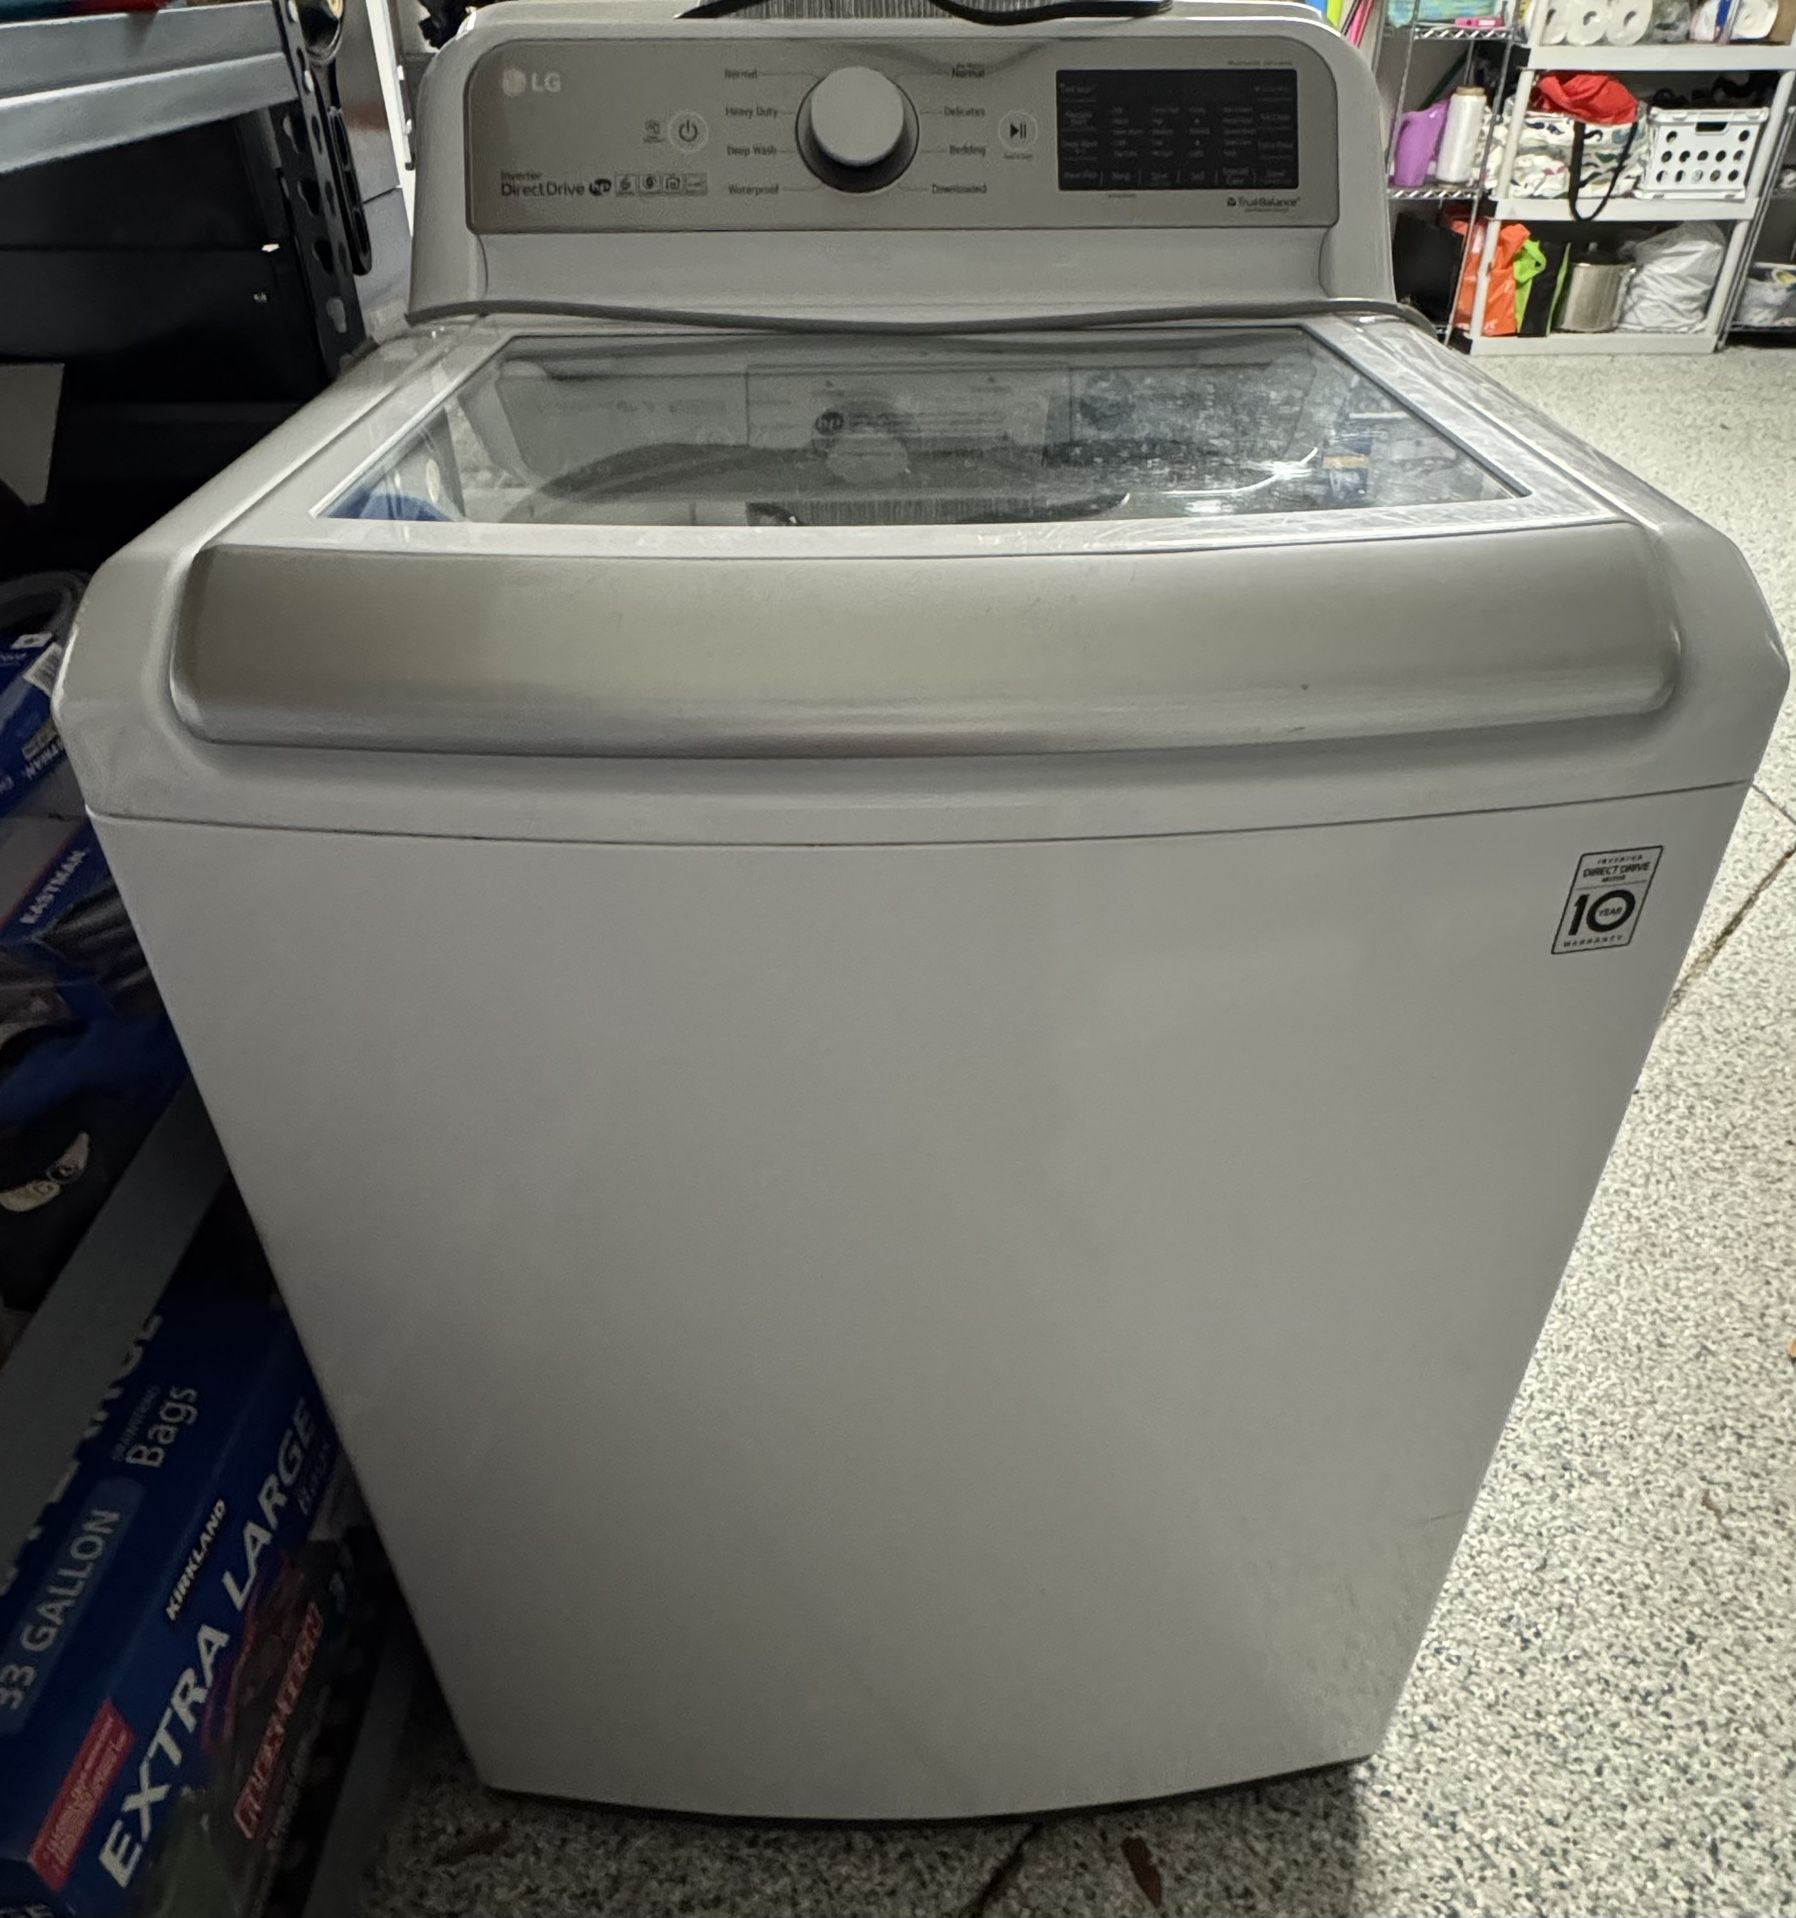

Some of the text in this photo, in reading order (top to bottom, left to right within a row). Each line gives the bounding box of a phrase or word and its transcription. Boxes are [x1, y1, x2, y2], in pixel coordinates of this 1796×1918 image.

[724, 67, 758, 79] Normal
[531, 71, 561, 93] LG
[725, 105, 778, 120] Heavy Duty
[943, 106, 986, 117] Delicates
[727, 145, 777, 158] Deep Wash
[948, 144, 986, 158] Bedding
[500, 170, 543, 181] Inverter
[728, 184, 780, 196] Waterproof
[931, 183, 988, 194] Downloaded
[1583, 861, 1652, 878] DIRECT DRIVE
[1568, 889, 1636, 936] 10
[1599, 906, 1622, 917] YEAR
[1563, 934, 1624, 948] WARRANTY
[126, 1385, 199, 1468] Bags
[165, 1499, 227, 1622] KIRKLAND
[20, 1507, 122, 1654] GALLON
[98, 1622, 230, 1888] EXTRA
[221, 1396, 318, 1611] LARGE
